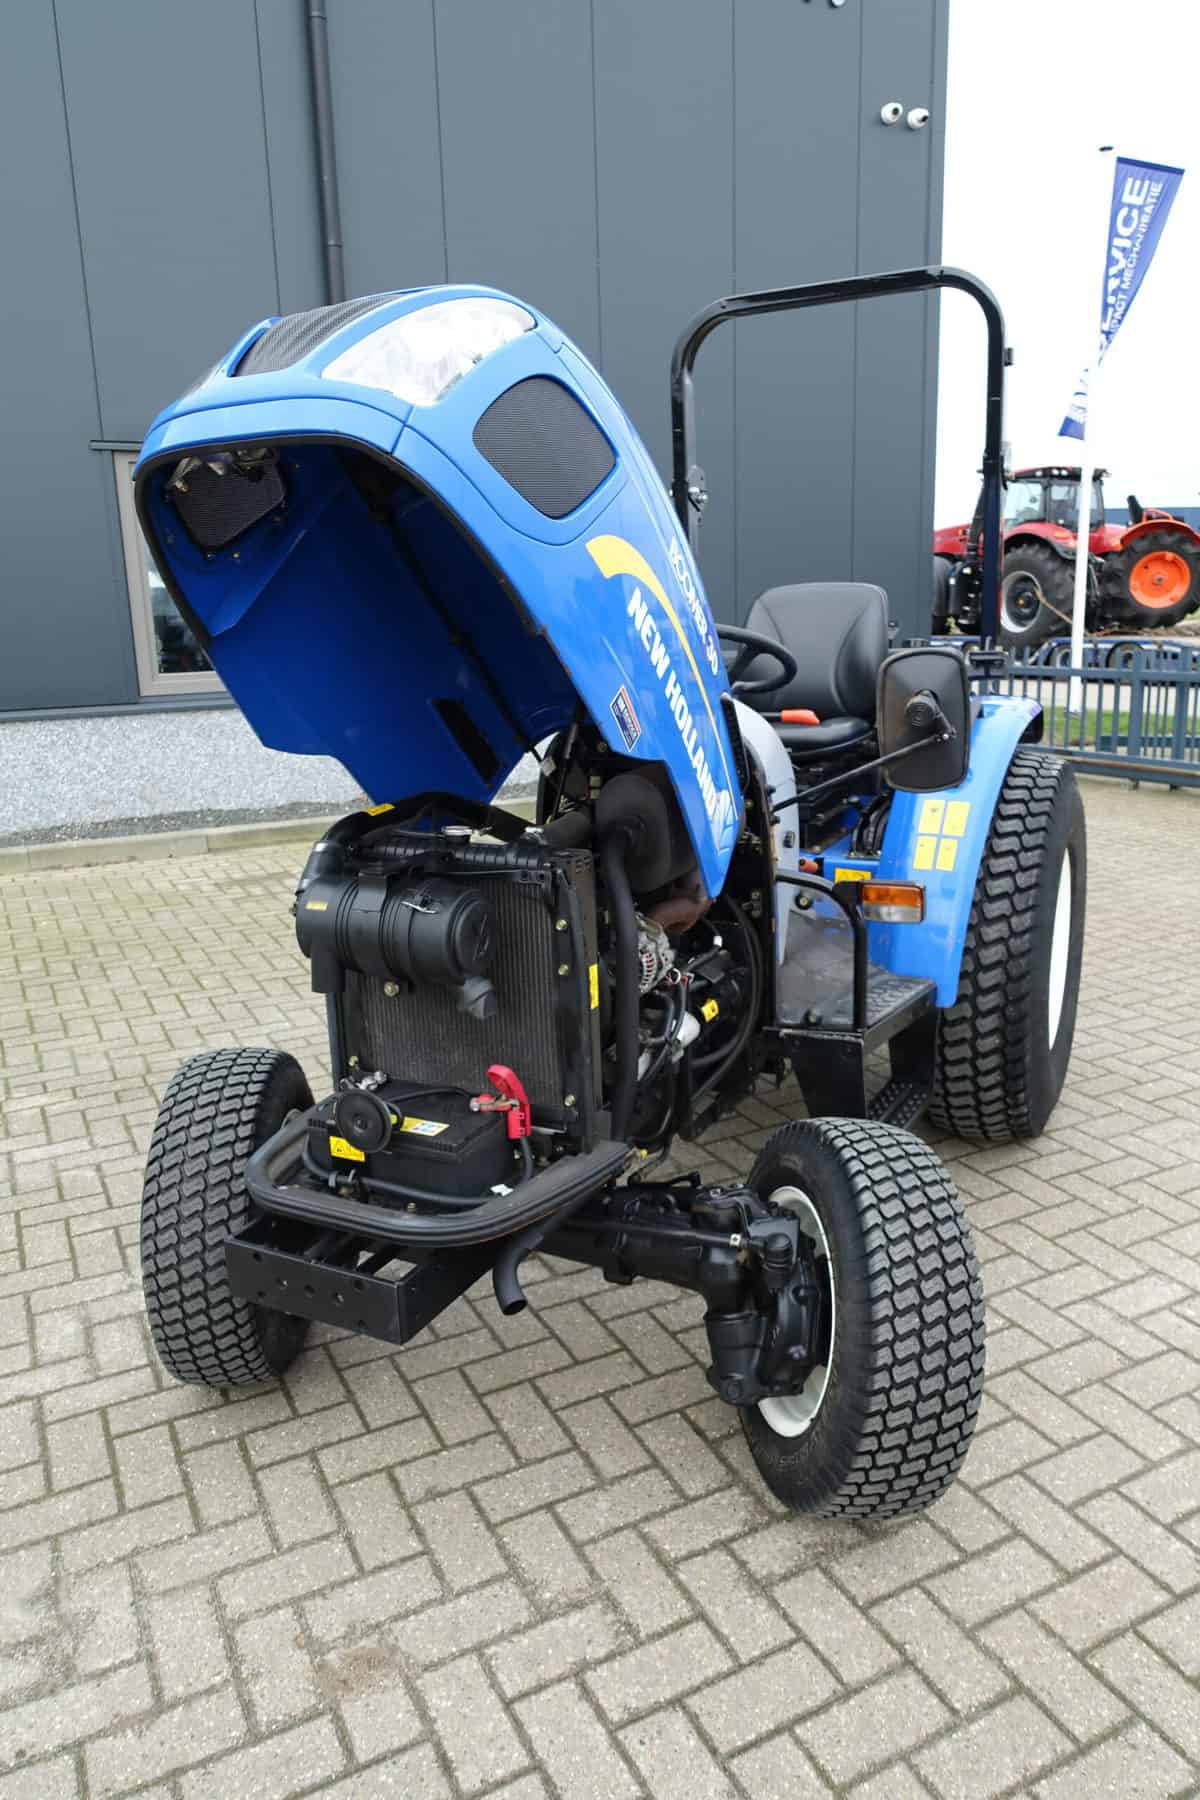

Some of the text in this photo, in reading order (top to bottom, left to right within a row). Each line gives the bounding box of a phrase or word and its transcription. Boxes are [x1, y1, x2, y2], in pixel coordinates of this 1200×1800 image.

[1101, 176, 1150, 332] ERVICE
[627, 587, 671, 680] NEW
[665, 670, 720, 819] HOLLAND
